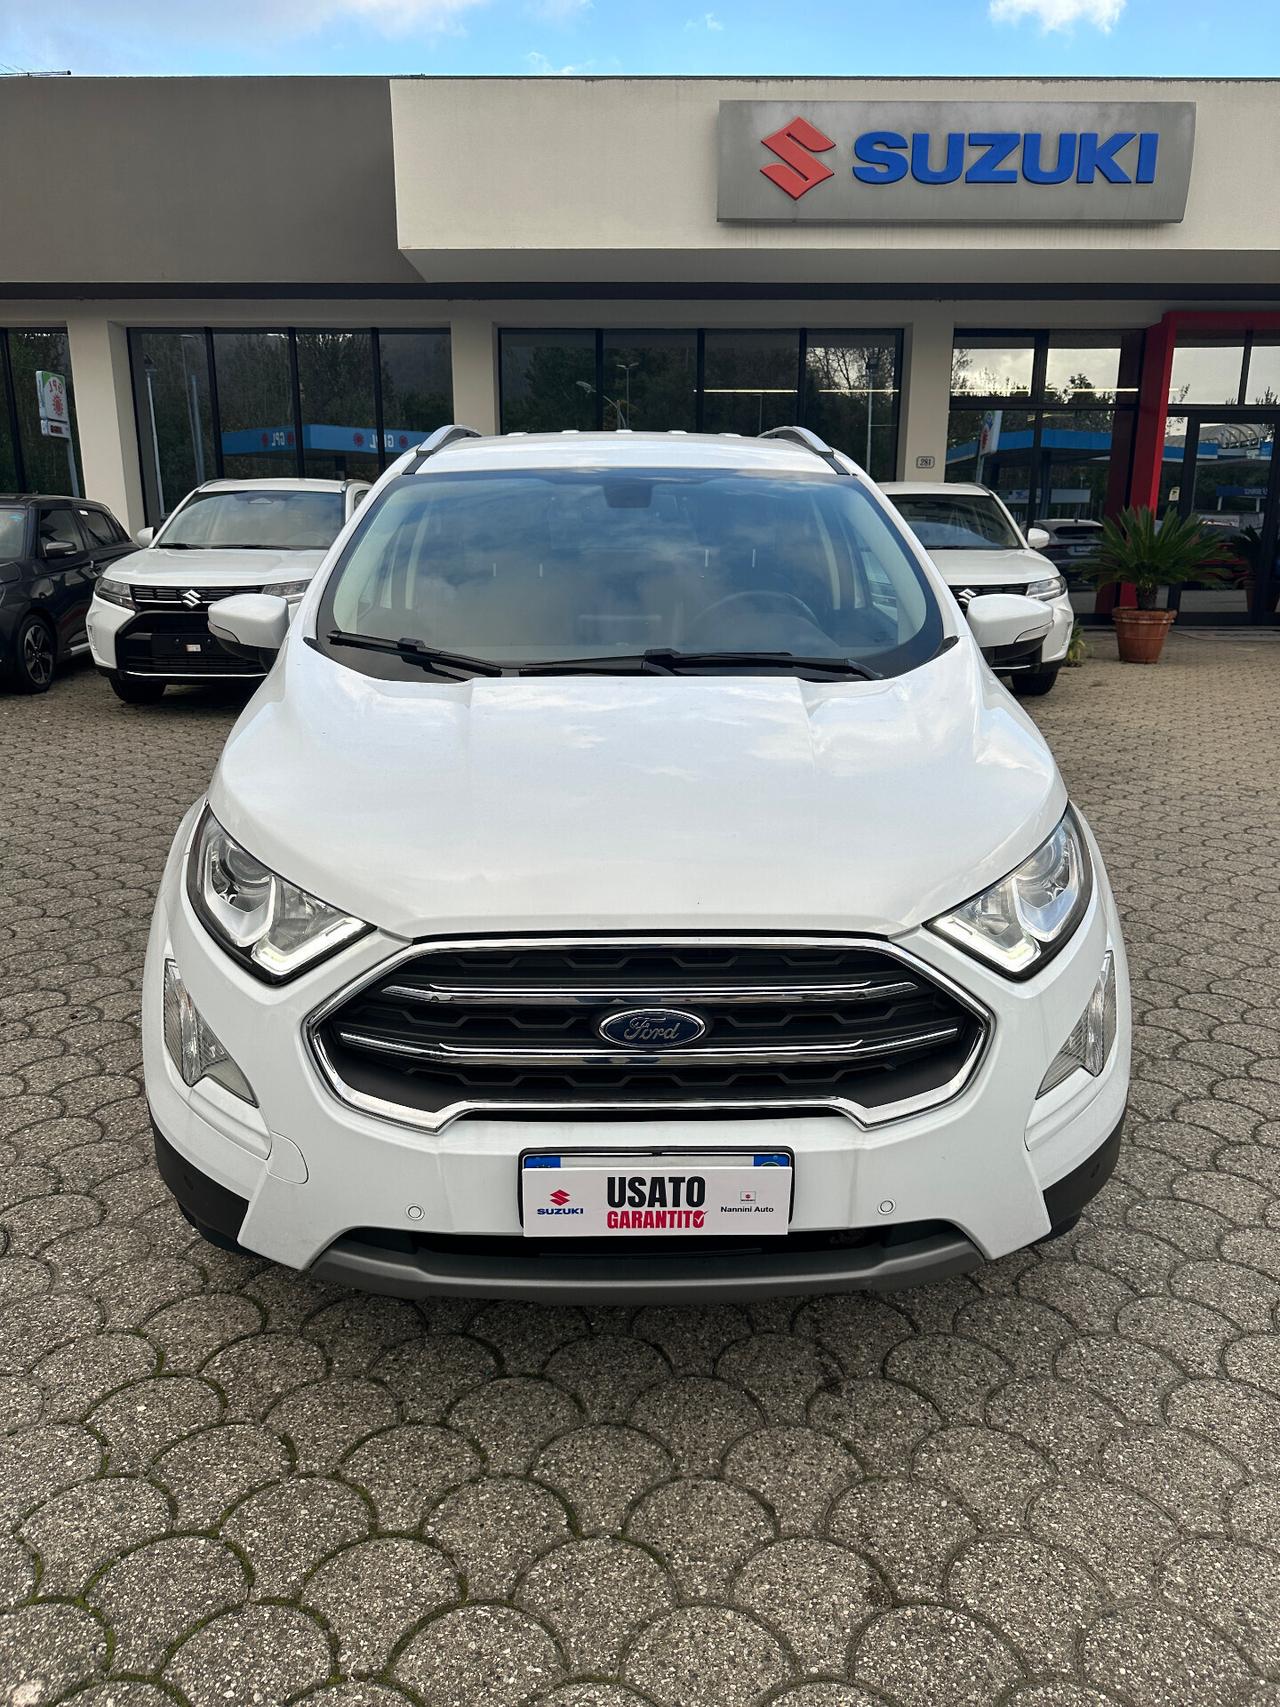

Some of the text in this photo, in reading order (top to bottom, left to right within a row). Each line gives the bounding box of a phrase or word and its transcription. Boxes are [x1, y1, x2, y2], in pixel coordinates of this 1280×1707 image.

[852, 131, 1159, 185] SUZUKI
[623, 1015, 681, 1041] Ford
[606, 1175, 706, 1208] USATO
[536, 1207, 584, 1215] SUZUKI
[606, 1210, 707, 1229] GARANTITO
[720, 1205, 753, 1213] Nannini
